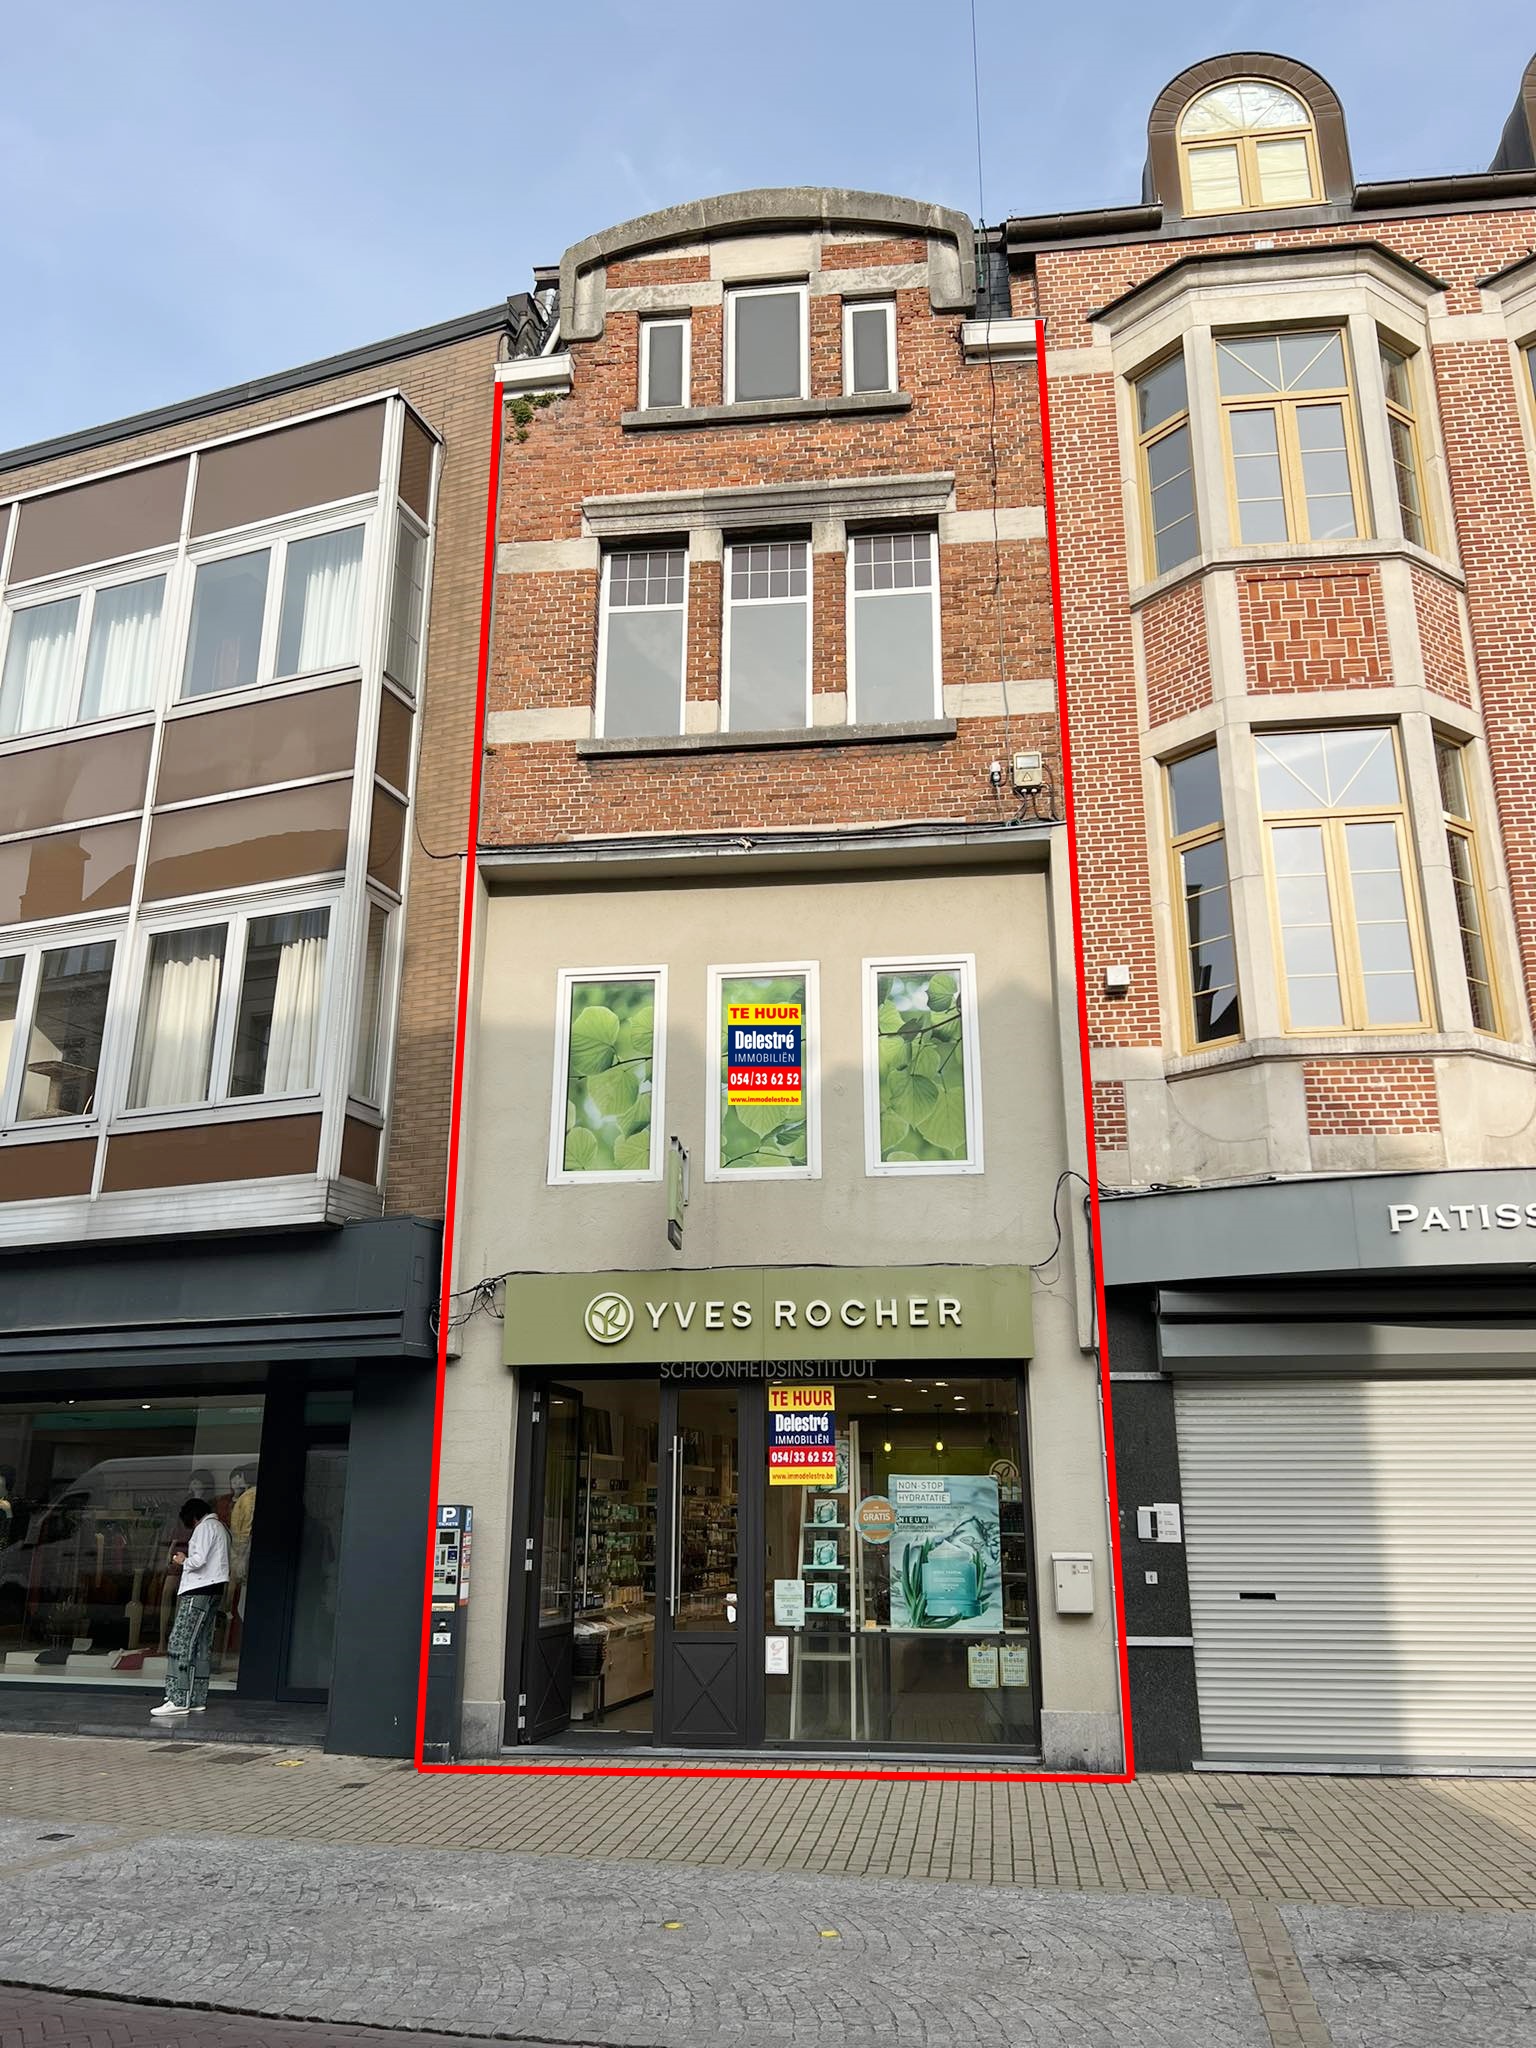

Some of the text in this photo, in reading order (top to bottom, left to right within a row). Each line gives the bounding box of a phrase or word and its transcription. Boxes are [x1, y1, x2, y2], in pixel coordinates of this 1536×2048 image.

[730, 1007, 800, 1019] TE HUUR
[735, 1029, 795, 1050] Delestré
[734, 1052, 795, 1063] IMMOBILIËN
[730, 1071, 800, 1086] 054/33 62 52
[645, 1298, 963, 1330] YVES ROCHER
[659, 1360, 877, 1379] SCHOONHEIDSINSTITUUT
[771, 1390, 833, 1406] TE HUUR
[775, 1411, 829, 1432] Delestré
[775, 1434, 830, 1445] IMMOBILIËN
[771, 1450, 834, 1463] 054/33 62 52
[442, 1506, 457, 1523] P
[862, 1512, 891, 1521] GRATIS
[899, 1516, 929, 1524] NIEUW
